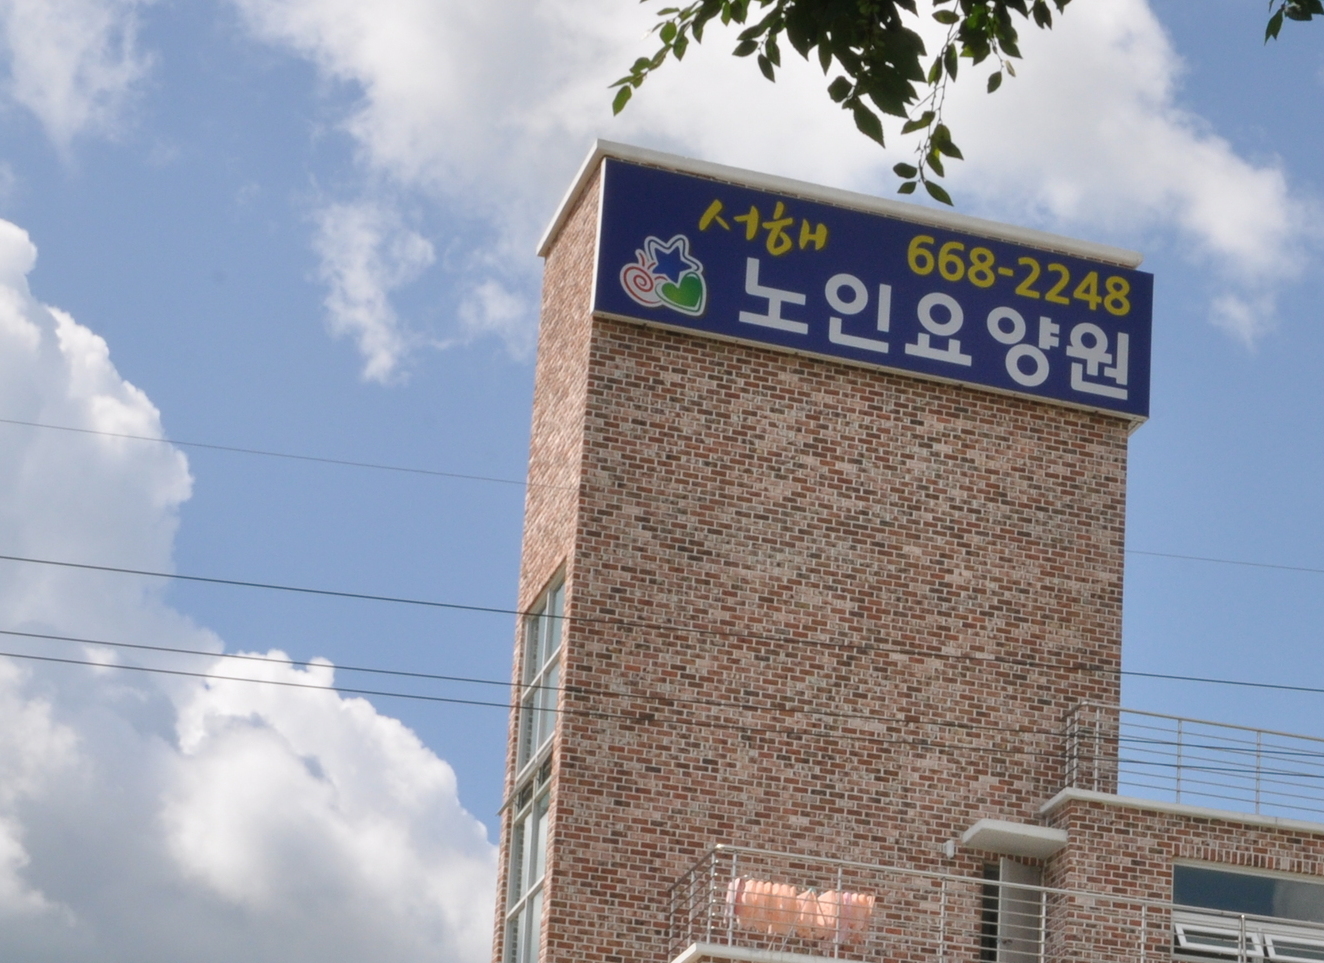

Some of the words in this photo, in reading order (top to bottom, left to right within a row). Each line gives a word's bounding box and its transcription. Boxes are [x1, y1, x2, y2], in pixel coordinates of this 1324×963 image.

[699, 200, 828, 256] 서해
[907, 235, 1131, 316] 668-2248
[739, 257, 1129, 400] 노인요양원
